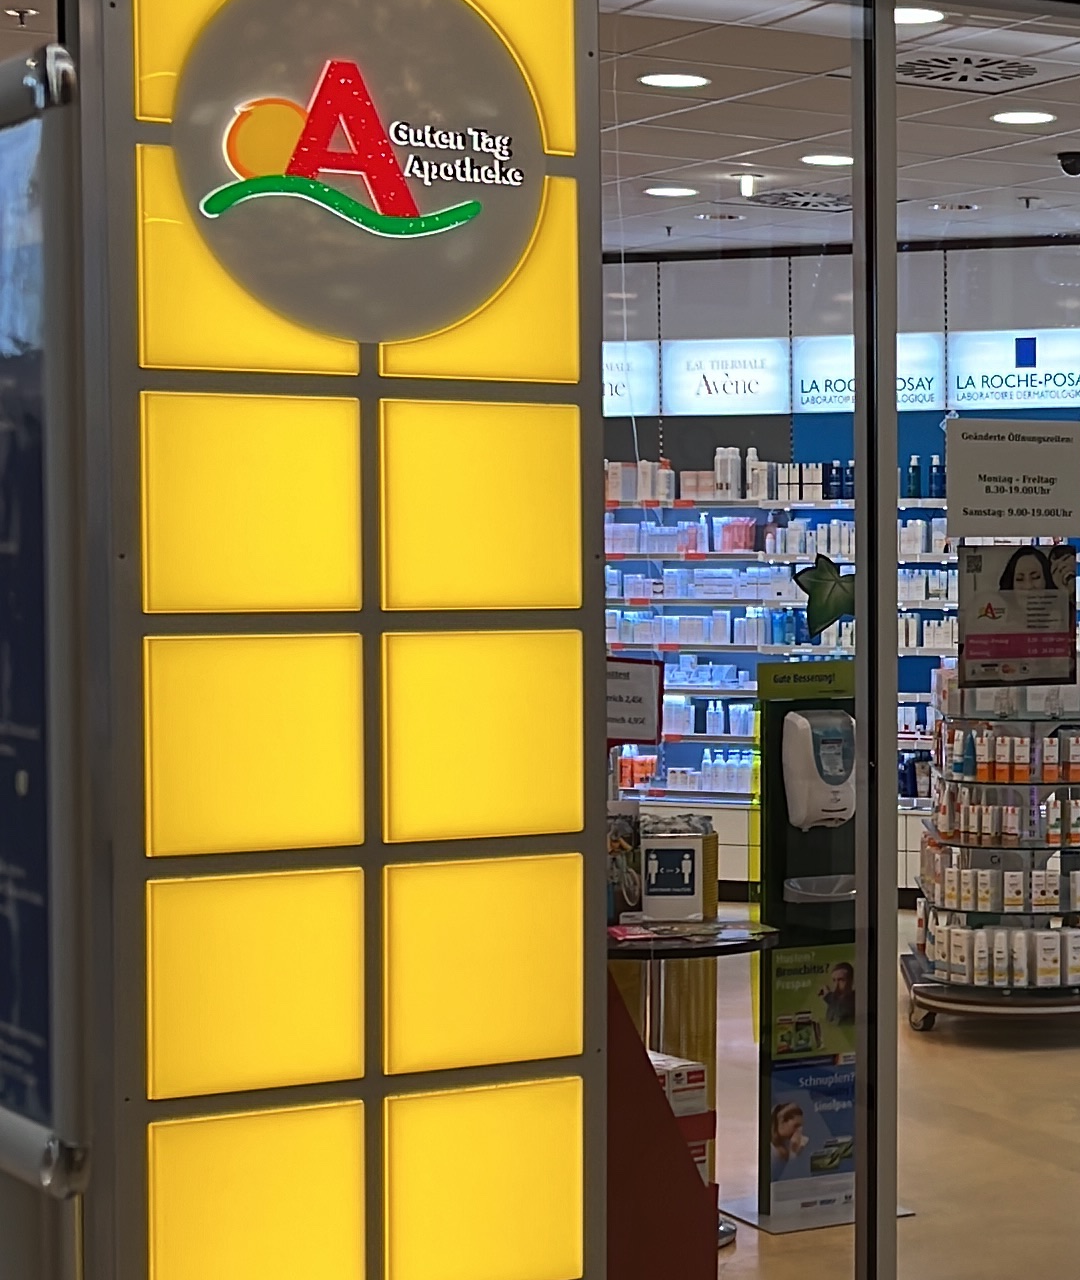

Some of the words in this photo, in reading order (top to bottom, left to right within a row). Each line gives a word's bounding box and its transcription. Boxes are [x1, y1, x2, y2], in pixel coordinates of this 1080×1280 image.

[389, 120, 466, 150] Guten
[466, 127, 512, 161] Tag
[403, 153, 524, 186] Apotheke
[708, 359, 768, 370] THERMALE
[696, 373, 760, 395] Avène
[801, 379, 820, 394] LA
[956, 375, 979, 390] LA
[961, 432, 1006, 441] Geänderte
[1007, 432, 1074, 444] Öffnungszeiten:
[978, 474, 1013, 484] Montag
[962, 507, 1005, 518] Samstag:
[773, 673, 791, 683] Gute
[793, 672, 836, 685] Besserung!
[799, 1073, 855, 1088] Schnupfen?
